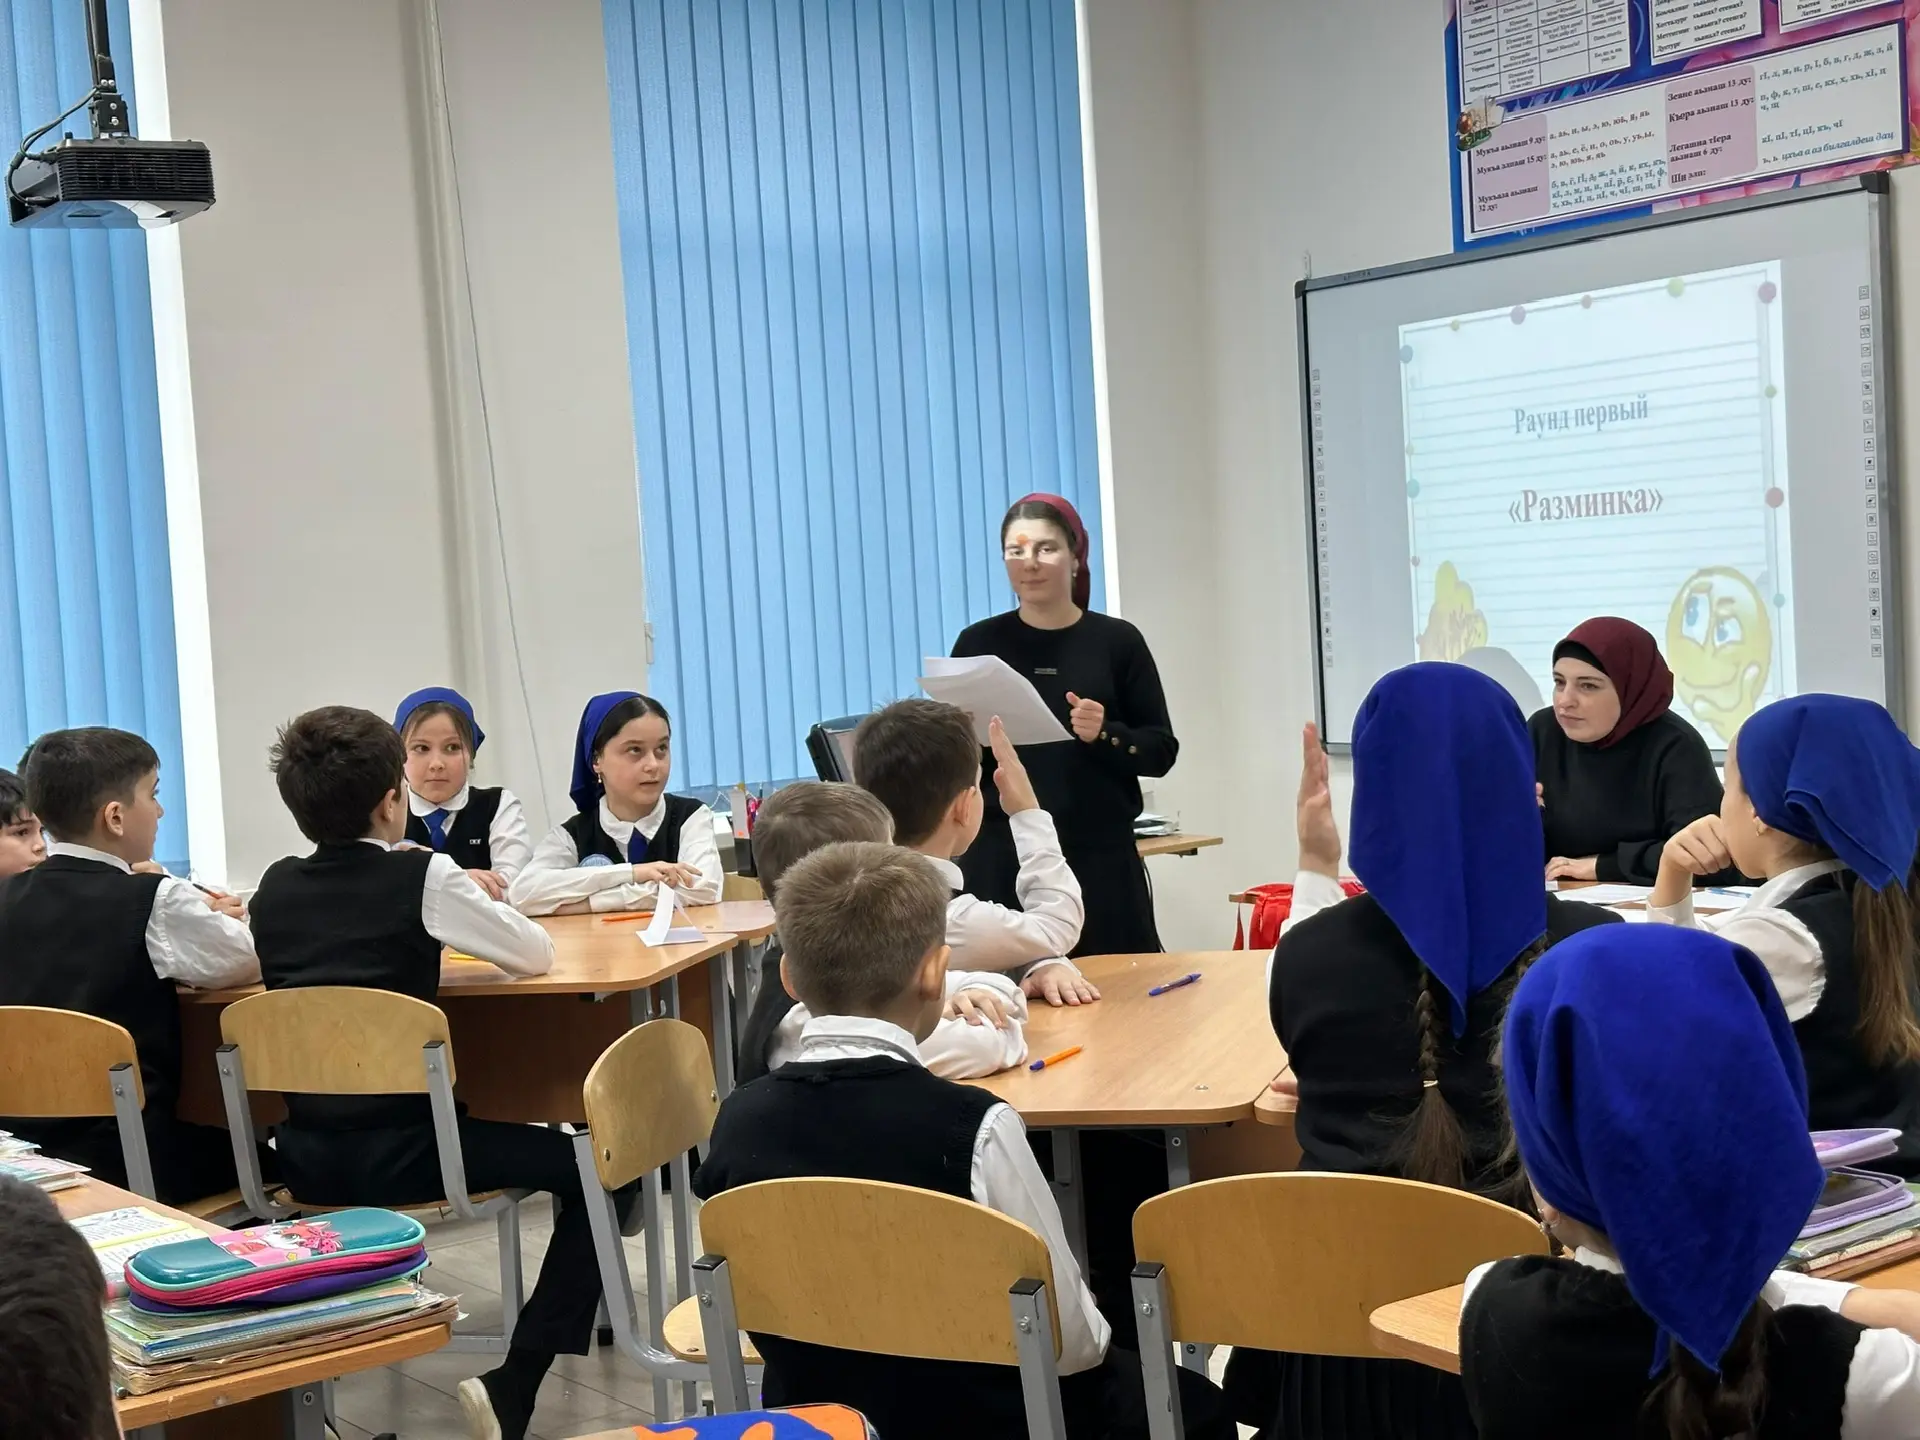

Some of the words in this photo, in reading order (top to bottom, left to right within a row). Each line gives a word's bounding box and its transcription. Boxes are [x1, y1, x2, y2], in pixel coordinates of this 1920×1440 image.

[1514, 409, 1569, 438] Раунд
[1574, 394, 1649, 431] первый
[1509, 488, 1663, 523] «Разминка»
